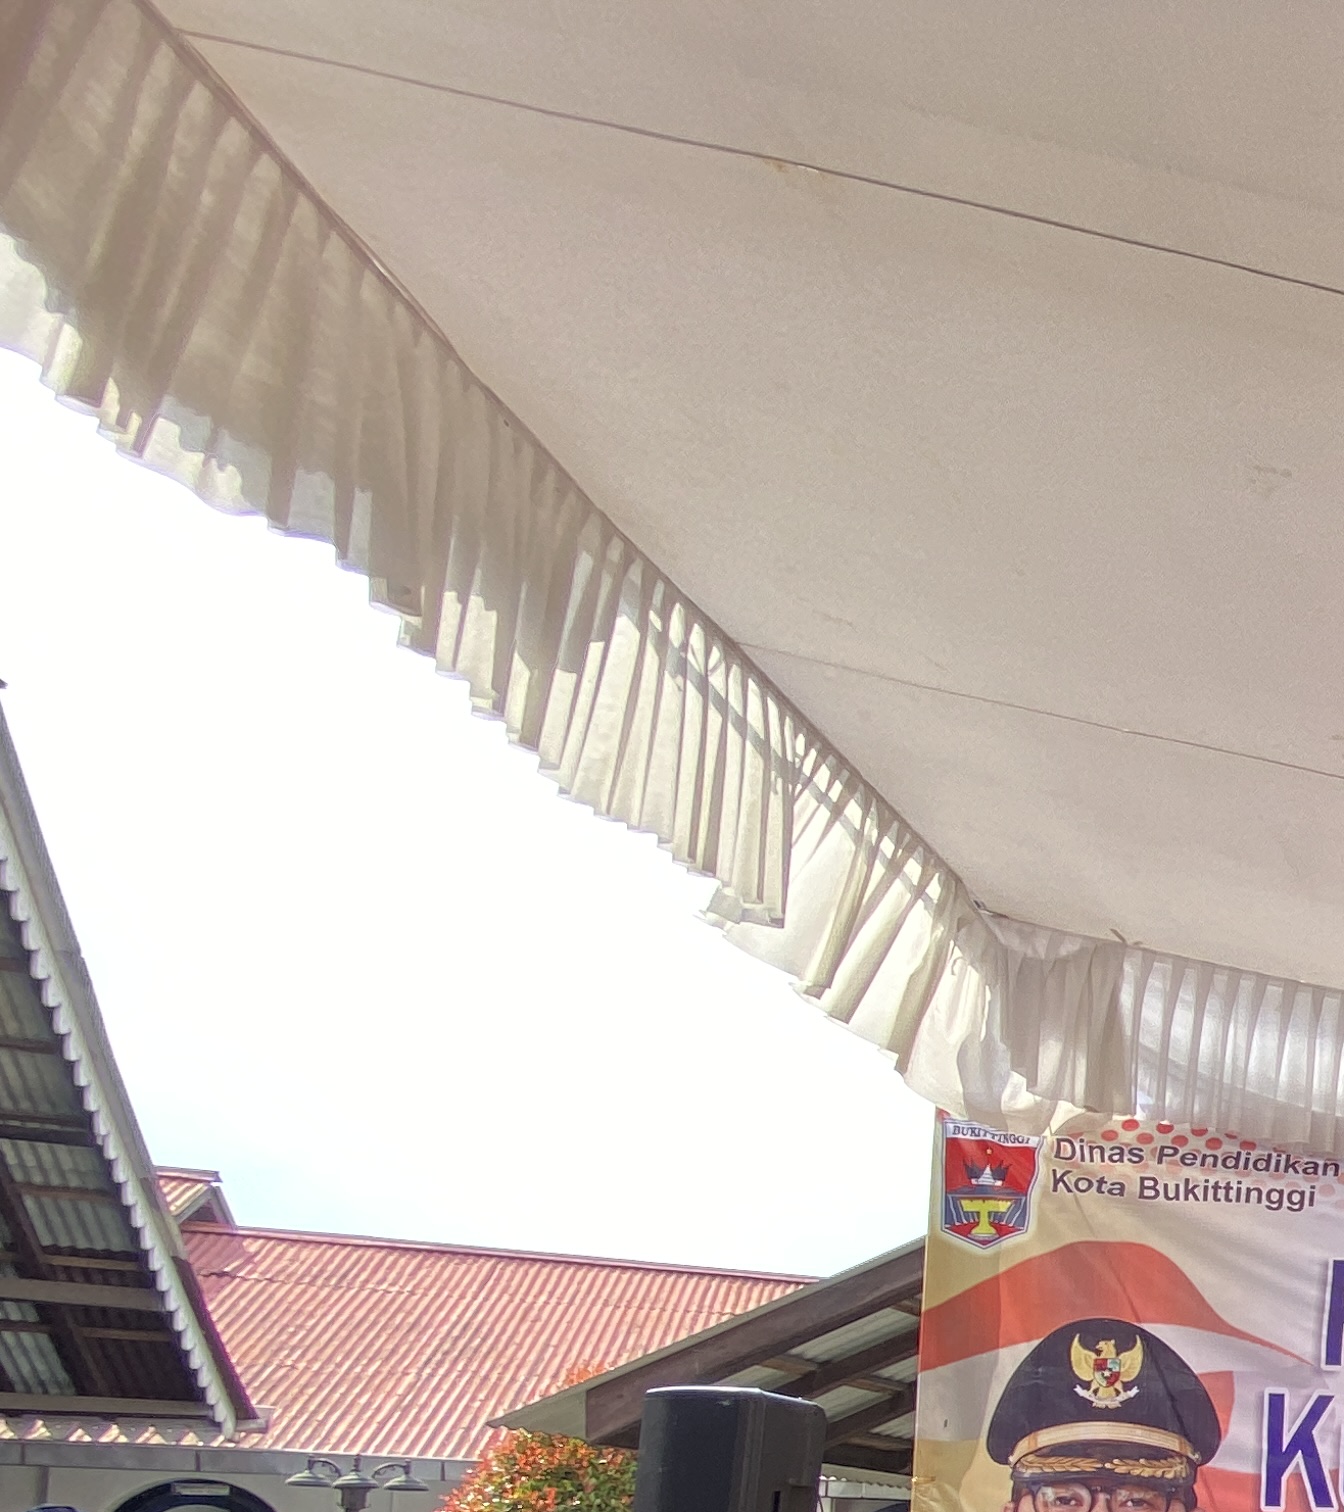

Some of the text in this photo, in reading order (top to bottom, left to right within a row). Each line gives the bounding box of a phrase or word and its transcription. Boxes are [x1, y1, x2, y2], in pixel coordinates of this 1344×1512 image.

[952, 1125, 1031, 1147] BUKITTINGGI
[1053, 1137, 1145, 1165] Dinas
[1156, 1144, 1340, 1178] Pendidikan
[1051, 1169, 1316, 1213] Kota Bukittinggi
